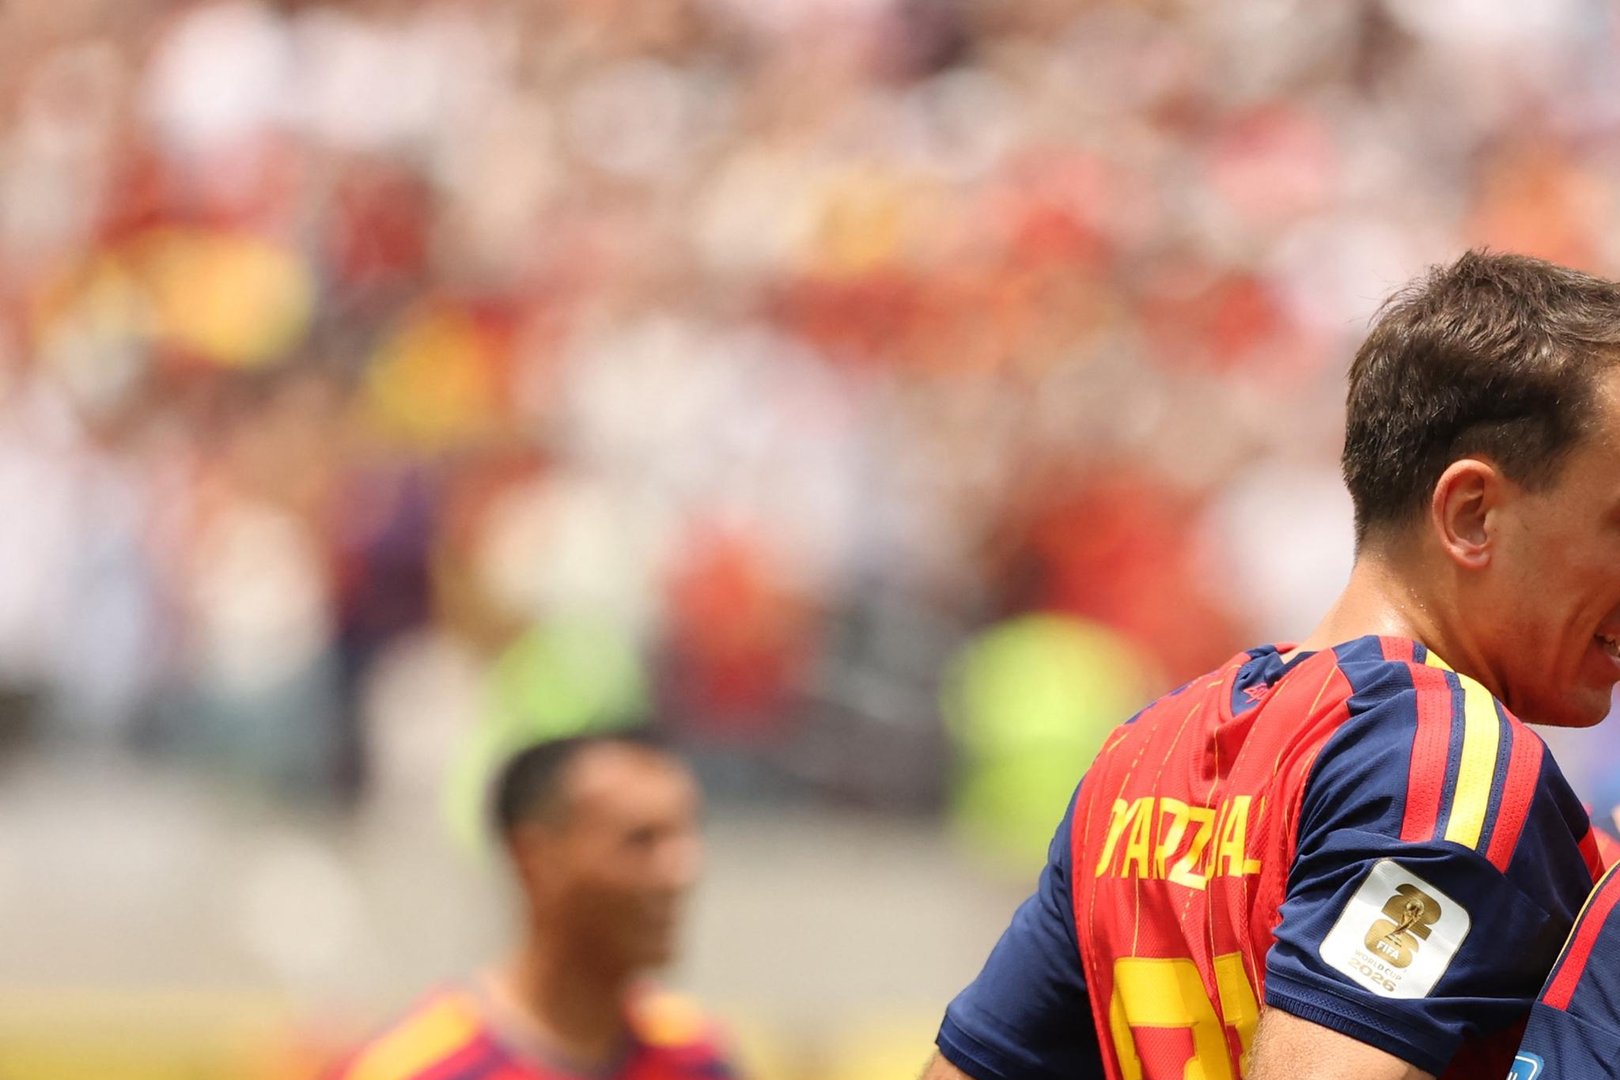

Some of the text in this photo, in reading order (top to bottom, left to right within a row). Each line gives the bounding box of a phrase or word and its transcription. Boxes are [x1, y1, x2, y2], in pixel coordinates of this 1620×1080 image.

[1355, 949, 1402, 981] WORLD CUP
[1376, 940, 1400, 960] FIFA
[1348, 957, 1397, 993] 2026
